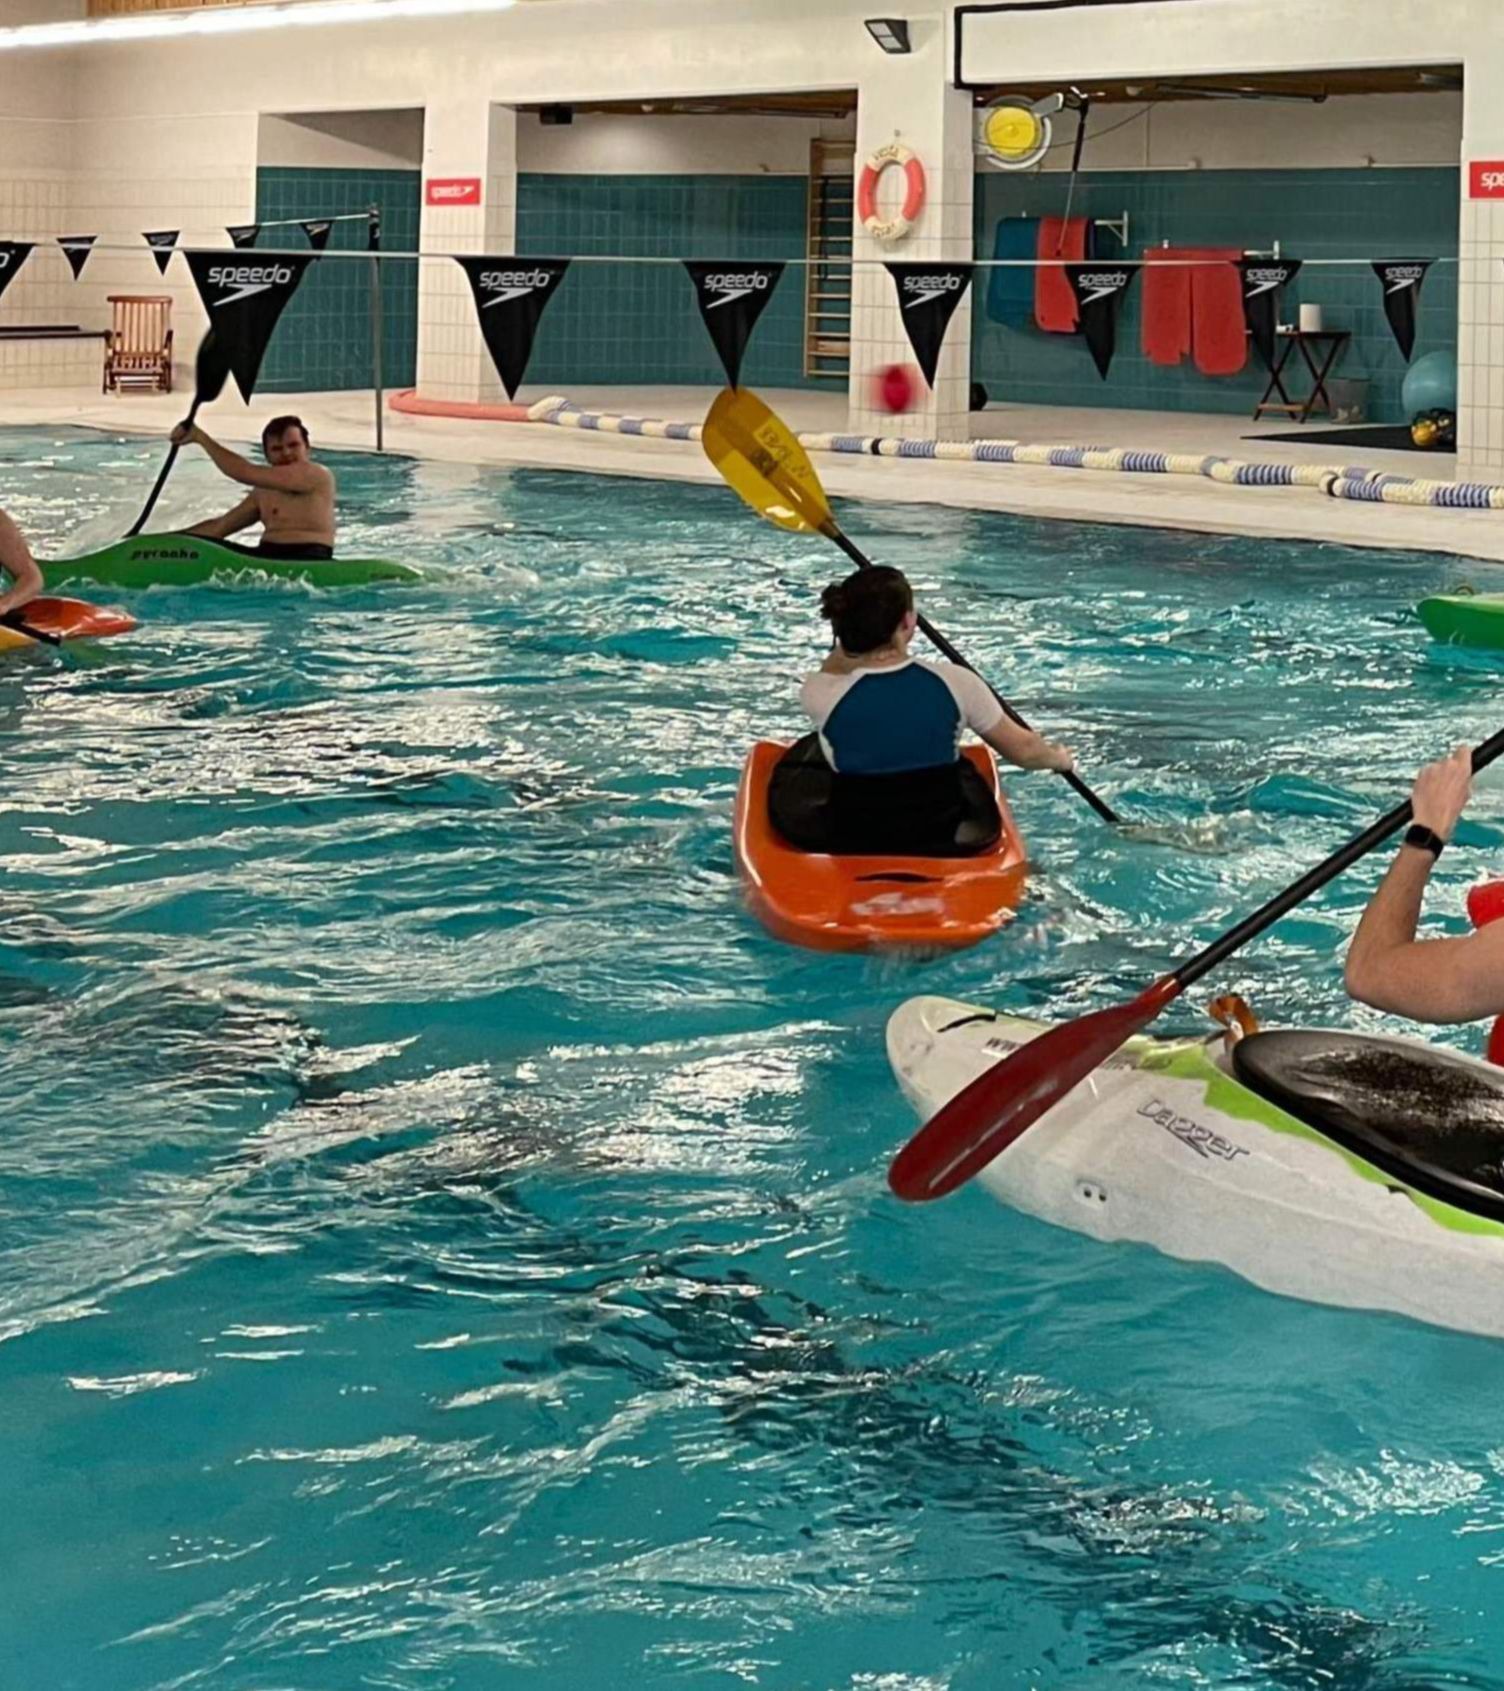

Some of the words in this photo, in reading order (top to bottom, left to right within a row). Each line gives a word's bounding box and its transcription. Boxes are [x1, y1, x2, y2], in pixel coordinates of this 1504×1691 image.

[208, 264, 291, 287] speedo
[479, 268, 550, 290] speedo
[704, 271, 768, 290] speedo
[903, 273, 961, 293] speedo
[1078, 271, 1127, 288] speedo
[1245, 266, 1288, 283] speedo
